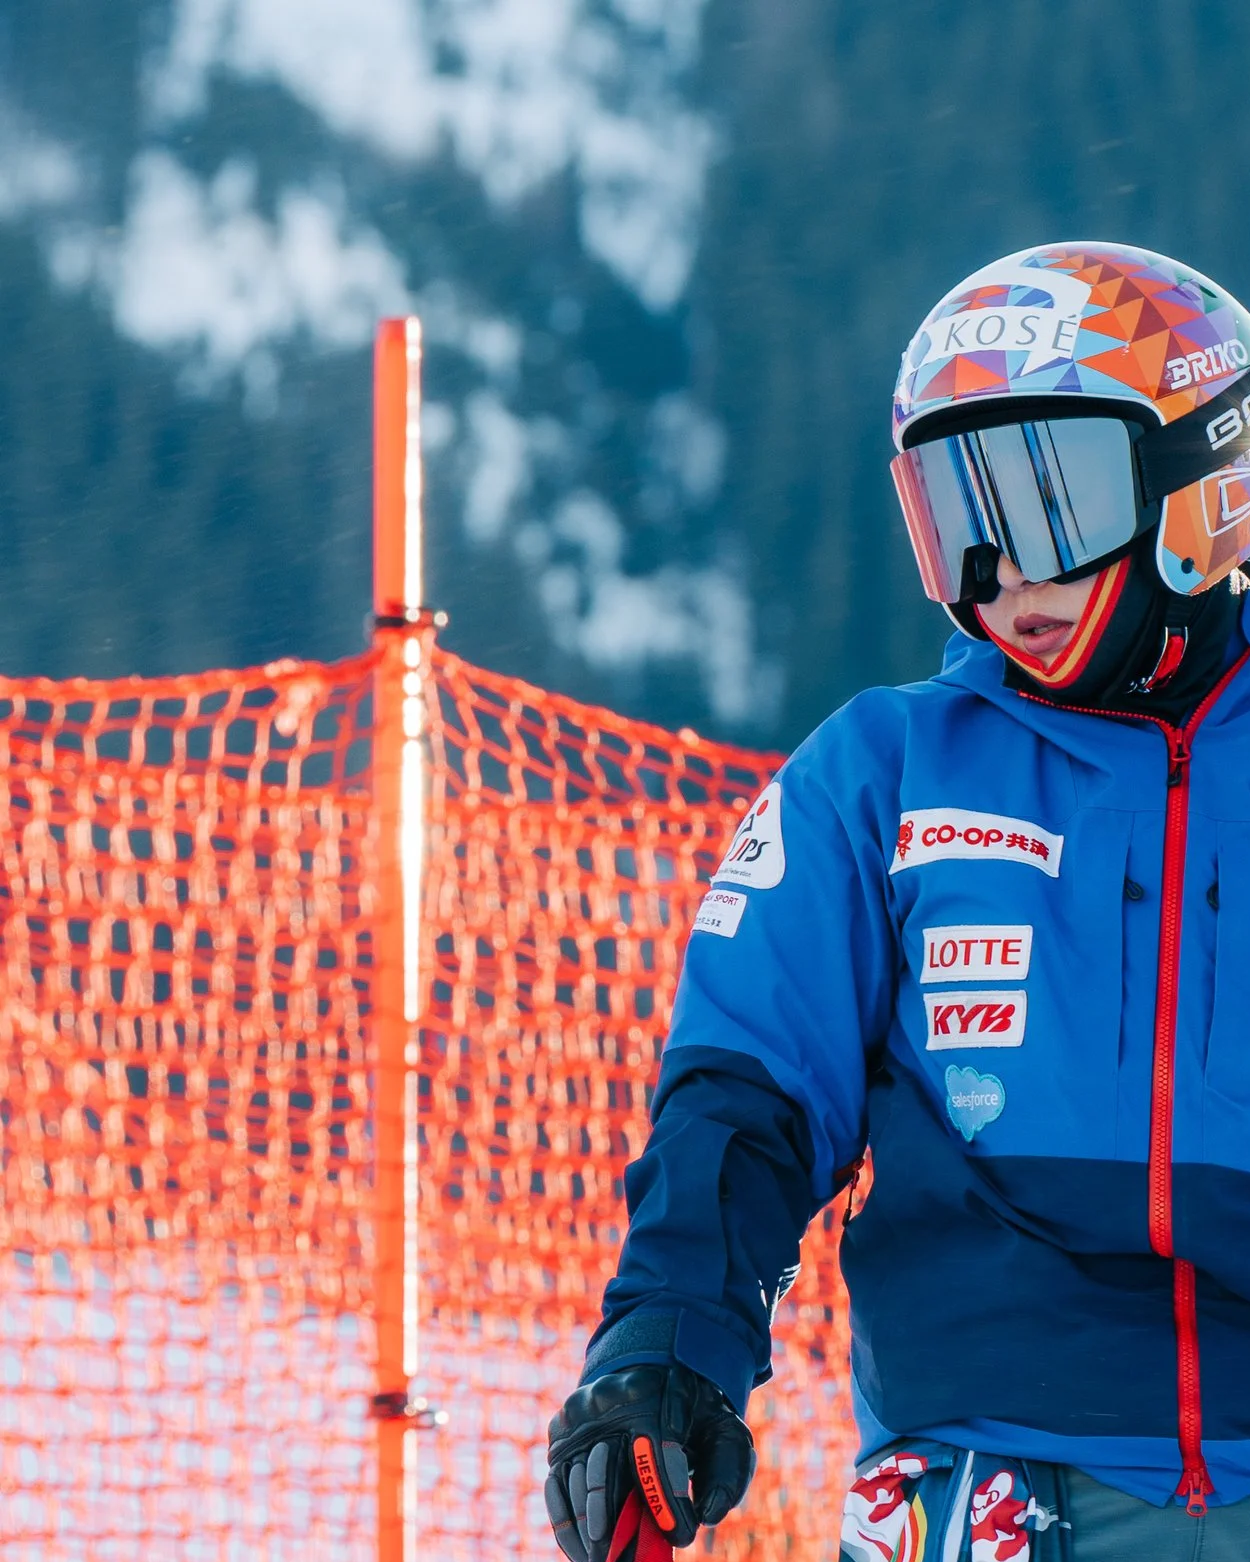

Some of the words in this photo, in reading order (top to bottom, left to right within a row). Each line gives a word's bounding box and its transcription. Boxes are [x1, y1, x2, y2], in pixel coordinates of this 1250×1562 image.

[944, 312, 1078, 353] KOSÉ
[1166, 338, 1249, 390] BRIKO
[929, 939, 1022, 969] LOTTE
[933, 1004, 1014, 1035] KYB
[951, 1091, 998, 1109] salesforce
[637, 1454, 663, 1516] HESTRA
